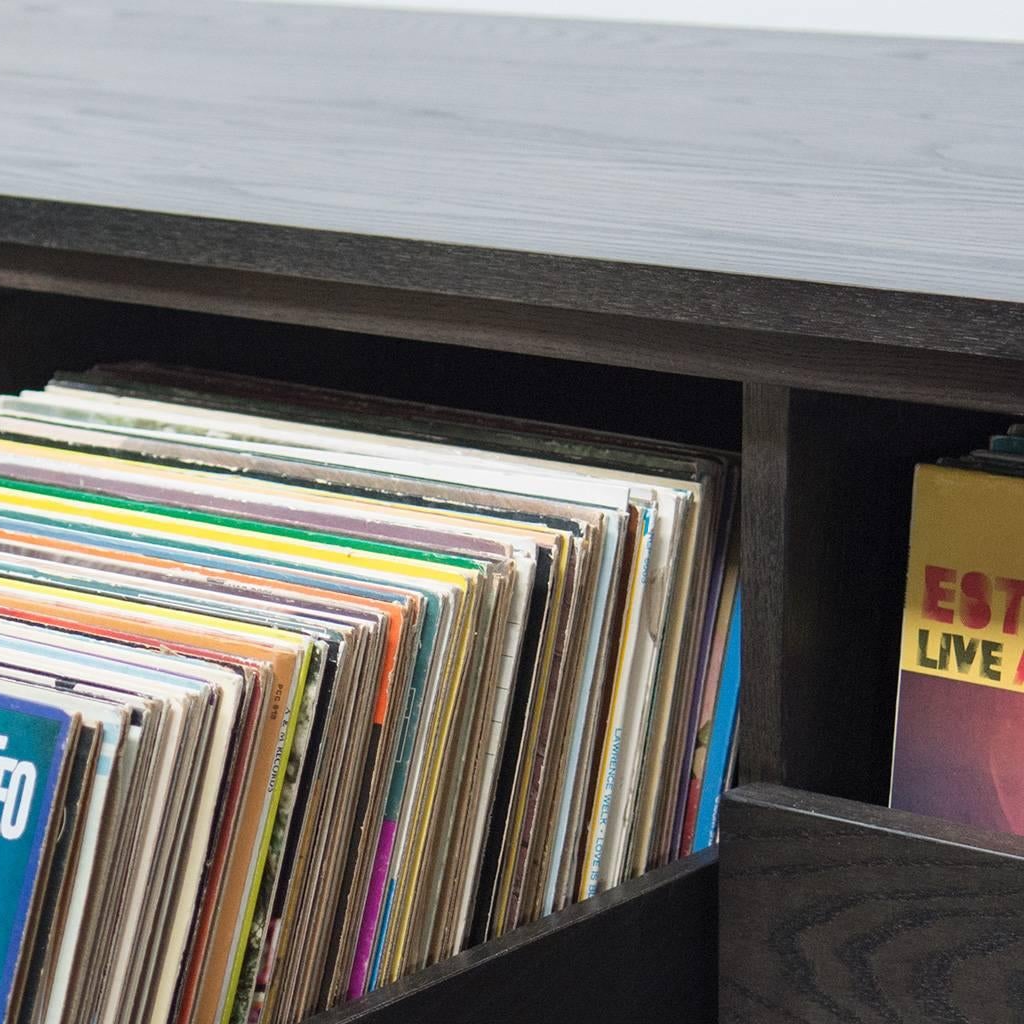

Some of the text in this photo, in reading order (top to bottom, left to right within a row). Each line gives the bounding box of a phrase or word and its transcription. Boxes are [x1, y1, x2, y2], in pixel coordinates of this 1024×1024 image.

[917, 628, 1003, 681] LIVE
[605, 727, 622, 791] LAWRENCE
[599, 794, 613, 825] WELK
[592, 837, 604, 867] LOVE
[590, 870, 600, 881] IS
